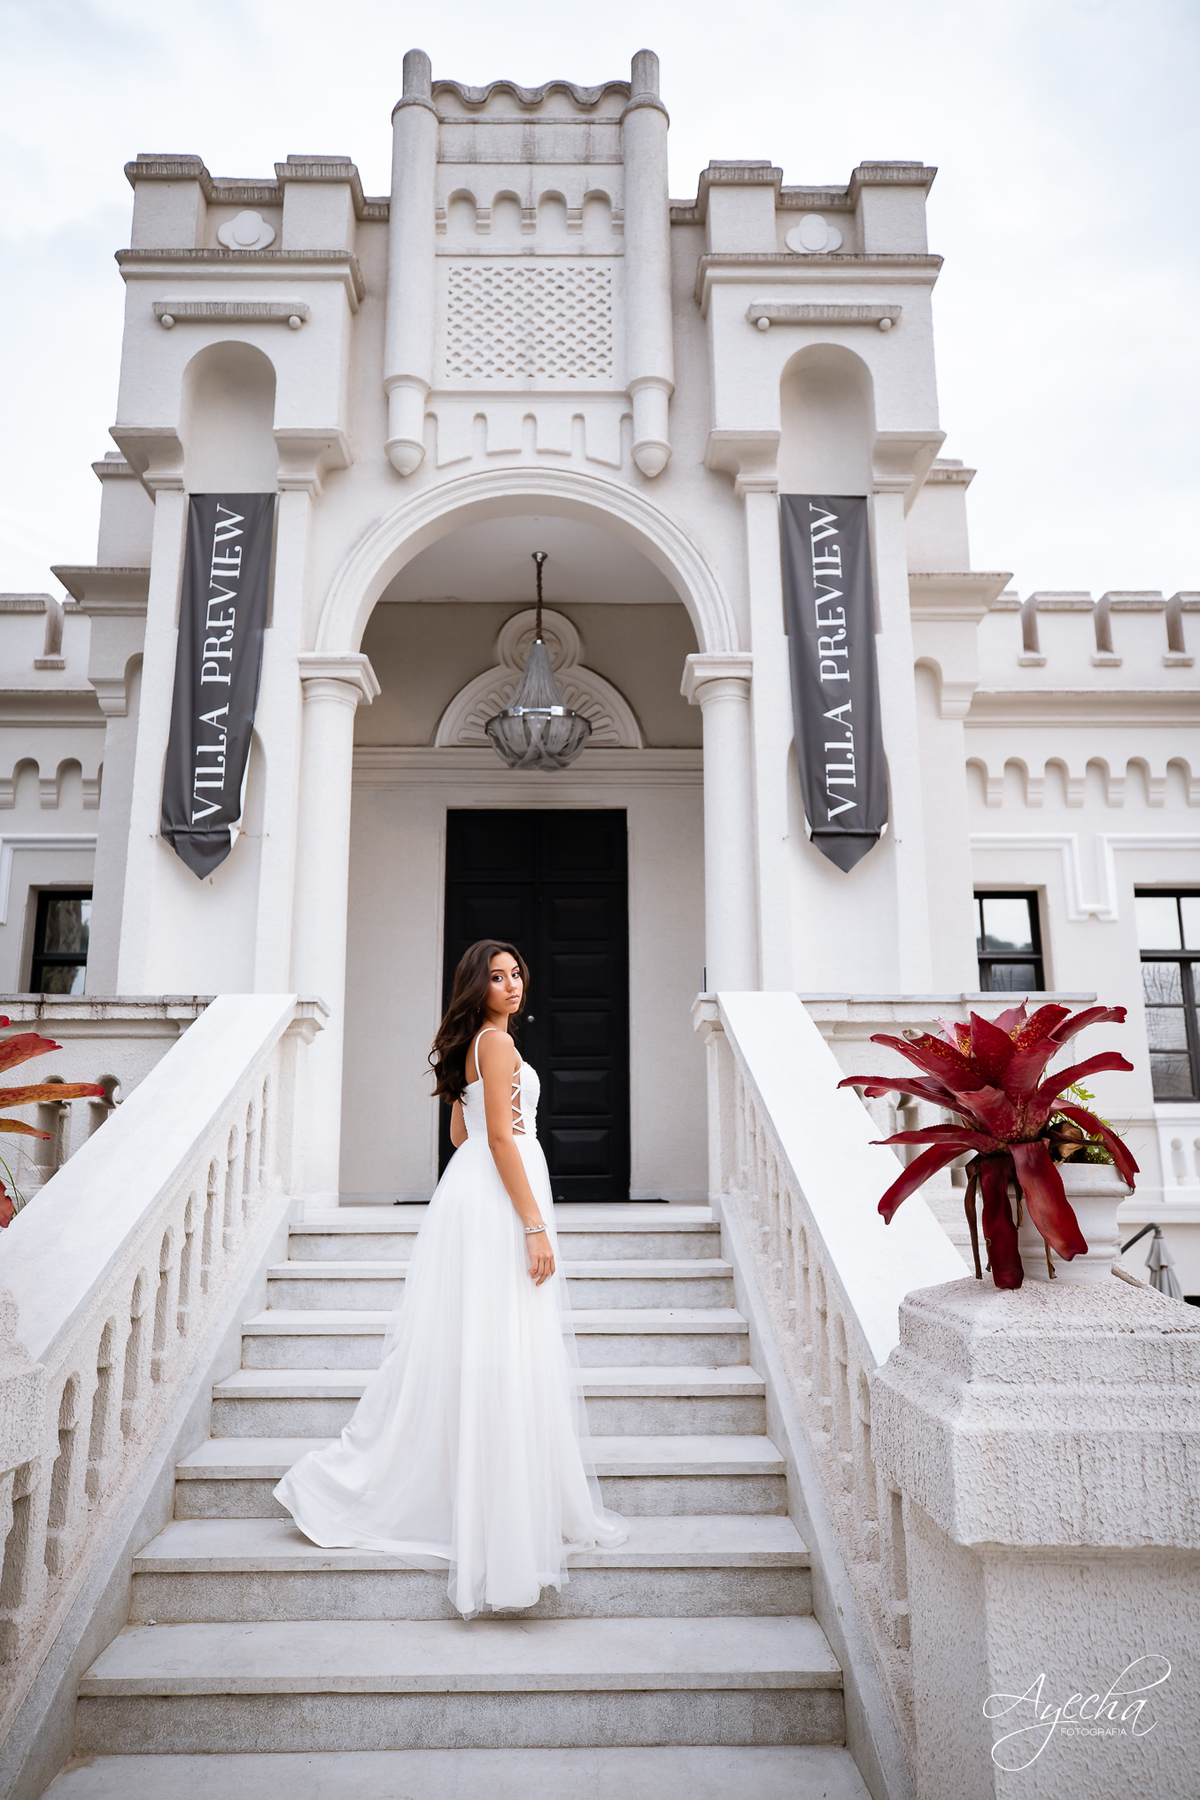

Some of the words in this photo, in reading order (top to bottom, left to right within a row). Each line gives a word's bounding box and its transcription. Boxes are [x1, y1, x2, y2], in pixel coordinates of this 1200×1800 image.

[201, 503, 245, 685] PREVIEW
[809, 503, 850, 682] PREVIEW
[192, 703, 229, 824] VILLA
[823, 700, 857, 821] VILLA
